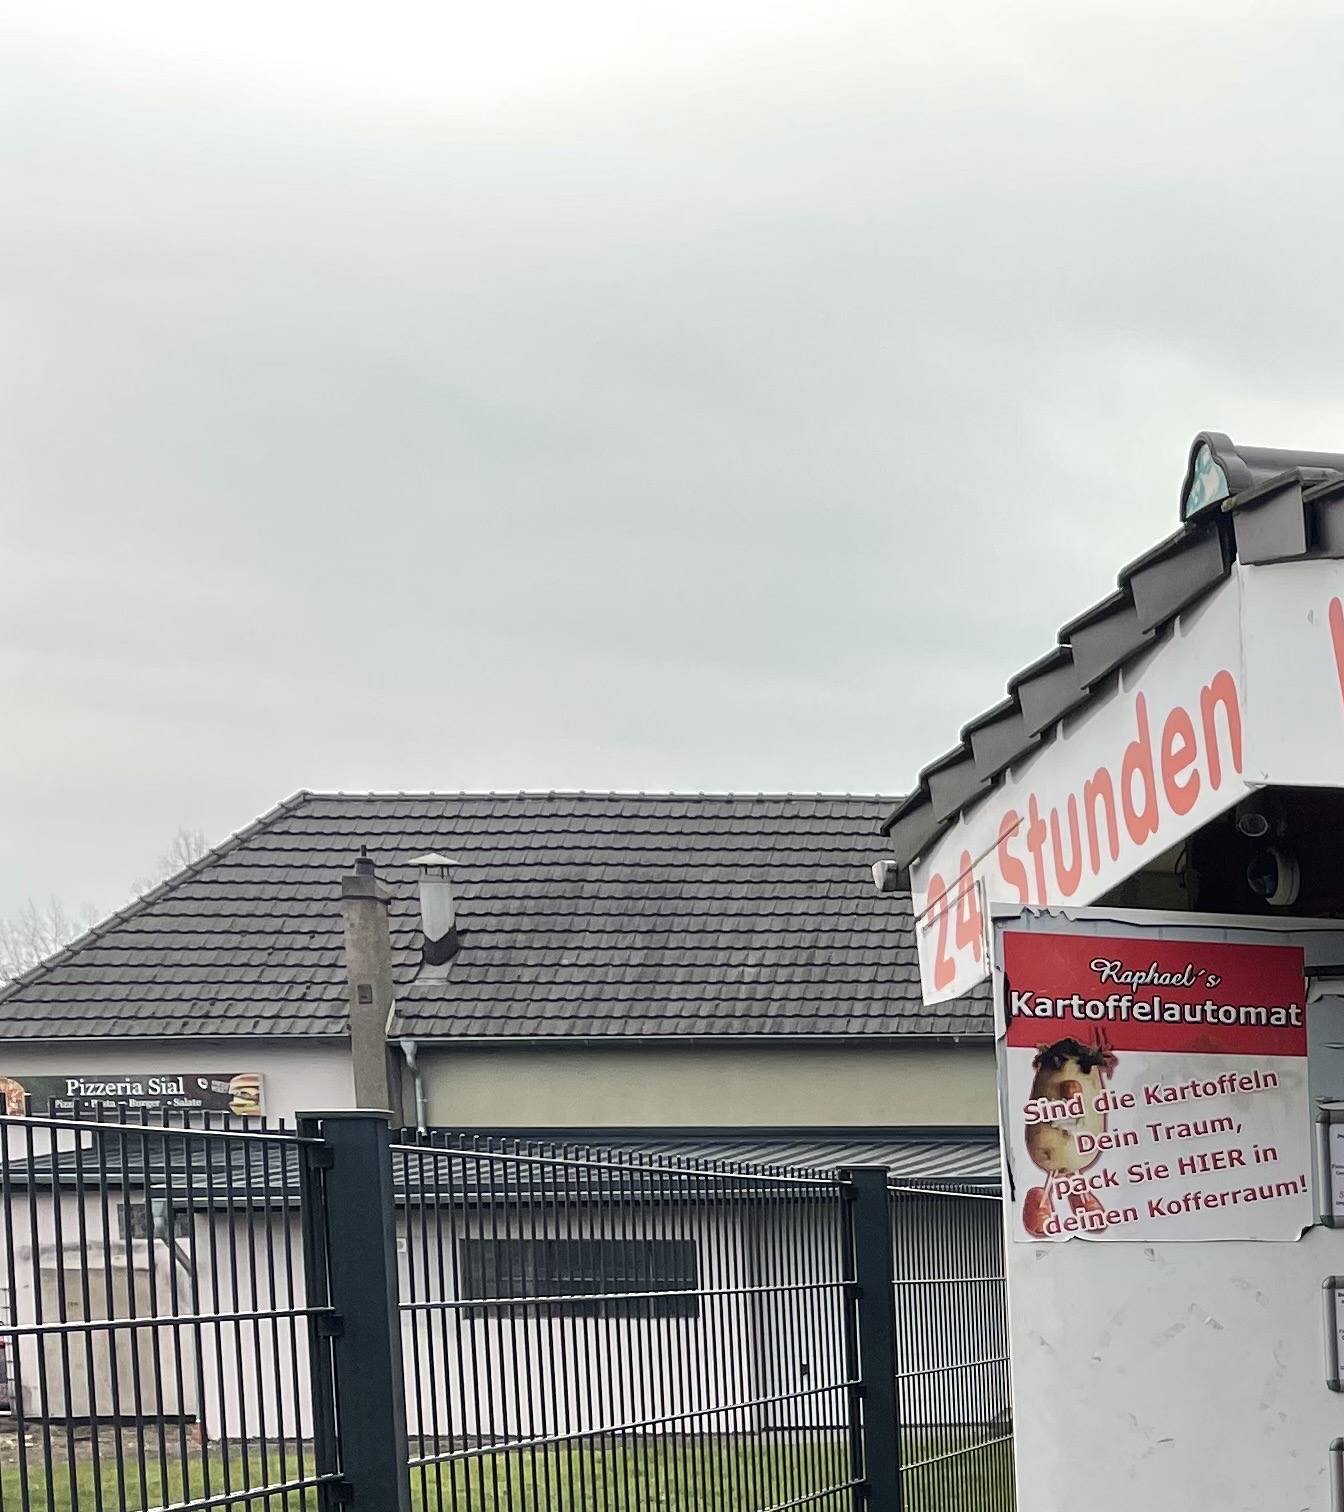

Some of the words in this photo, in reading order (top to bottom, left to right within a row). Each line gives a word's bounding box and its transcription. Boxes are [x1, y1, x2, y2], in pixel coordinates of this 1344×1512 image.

[927, 850, 981, 990] 24
[998, 670, 1242, 905] Stunden
[1010, 991, 1302, 1026] Kartoffelautomat
[66, 1077, 144, 1096] Pizzeria
[148, 1076, 185, 1095] Sial
[91, 1099, 116, 1108] Psta
[1023, 1093, 1084, 1124] Sind
[1093, 1086, 1135, 1113] die
[1143, 1070, 1278, 1105] Kartoffeln
[1077, 1130, 1138, 1154] Dein
[1146, 1115, 1243, 1143] Traum,
[1054, 1166, 1119, 1200] pack
[1128, 1157, 1169, 1184] Sie
[1178, 1148, 1246, 1176] HIER
[1253, 1143, 1278, 1164] in
[1044, 1206, 1139, 1235] deinen
[1148, 1175, 1308, 1220] Kofferraum!
